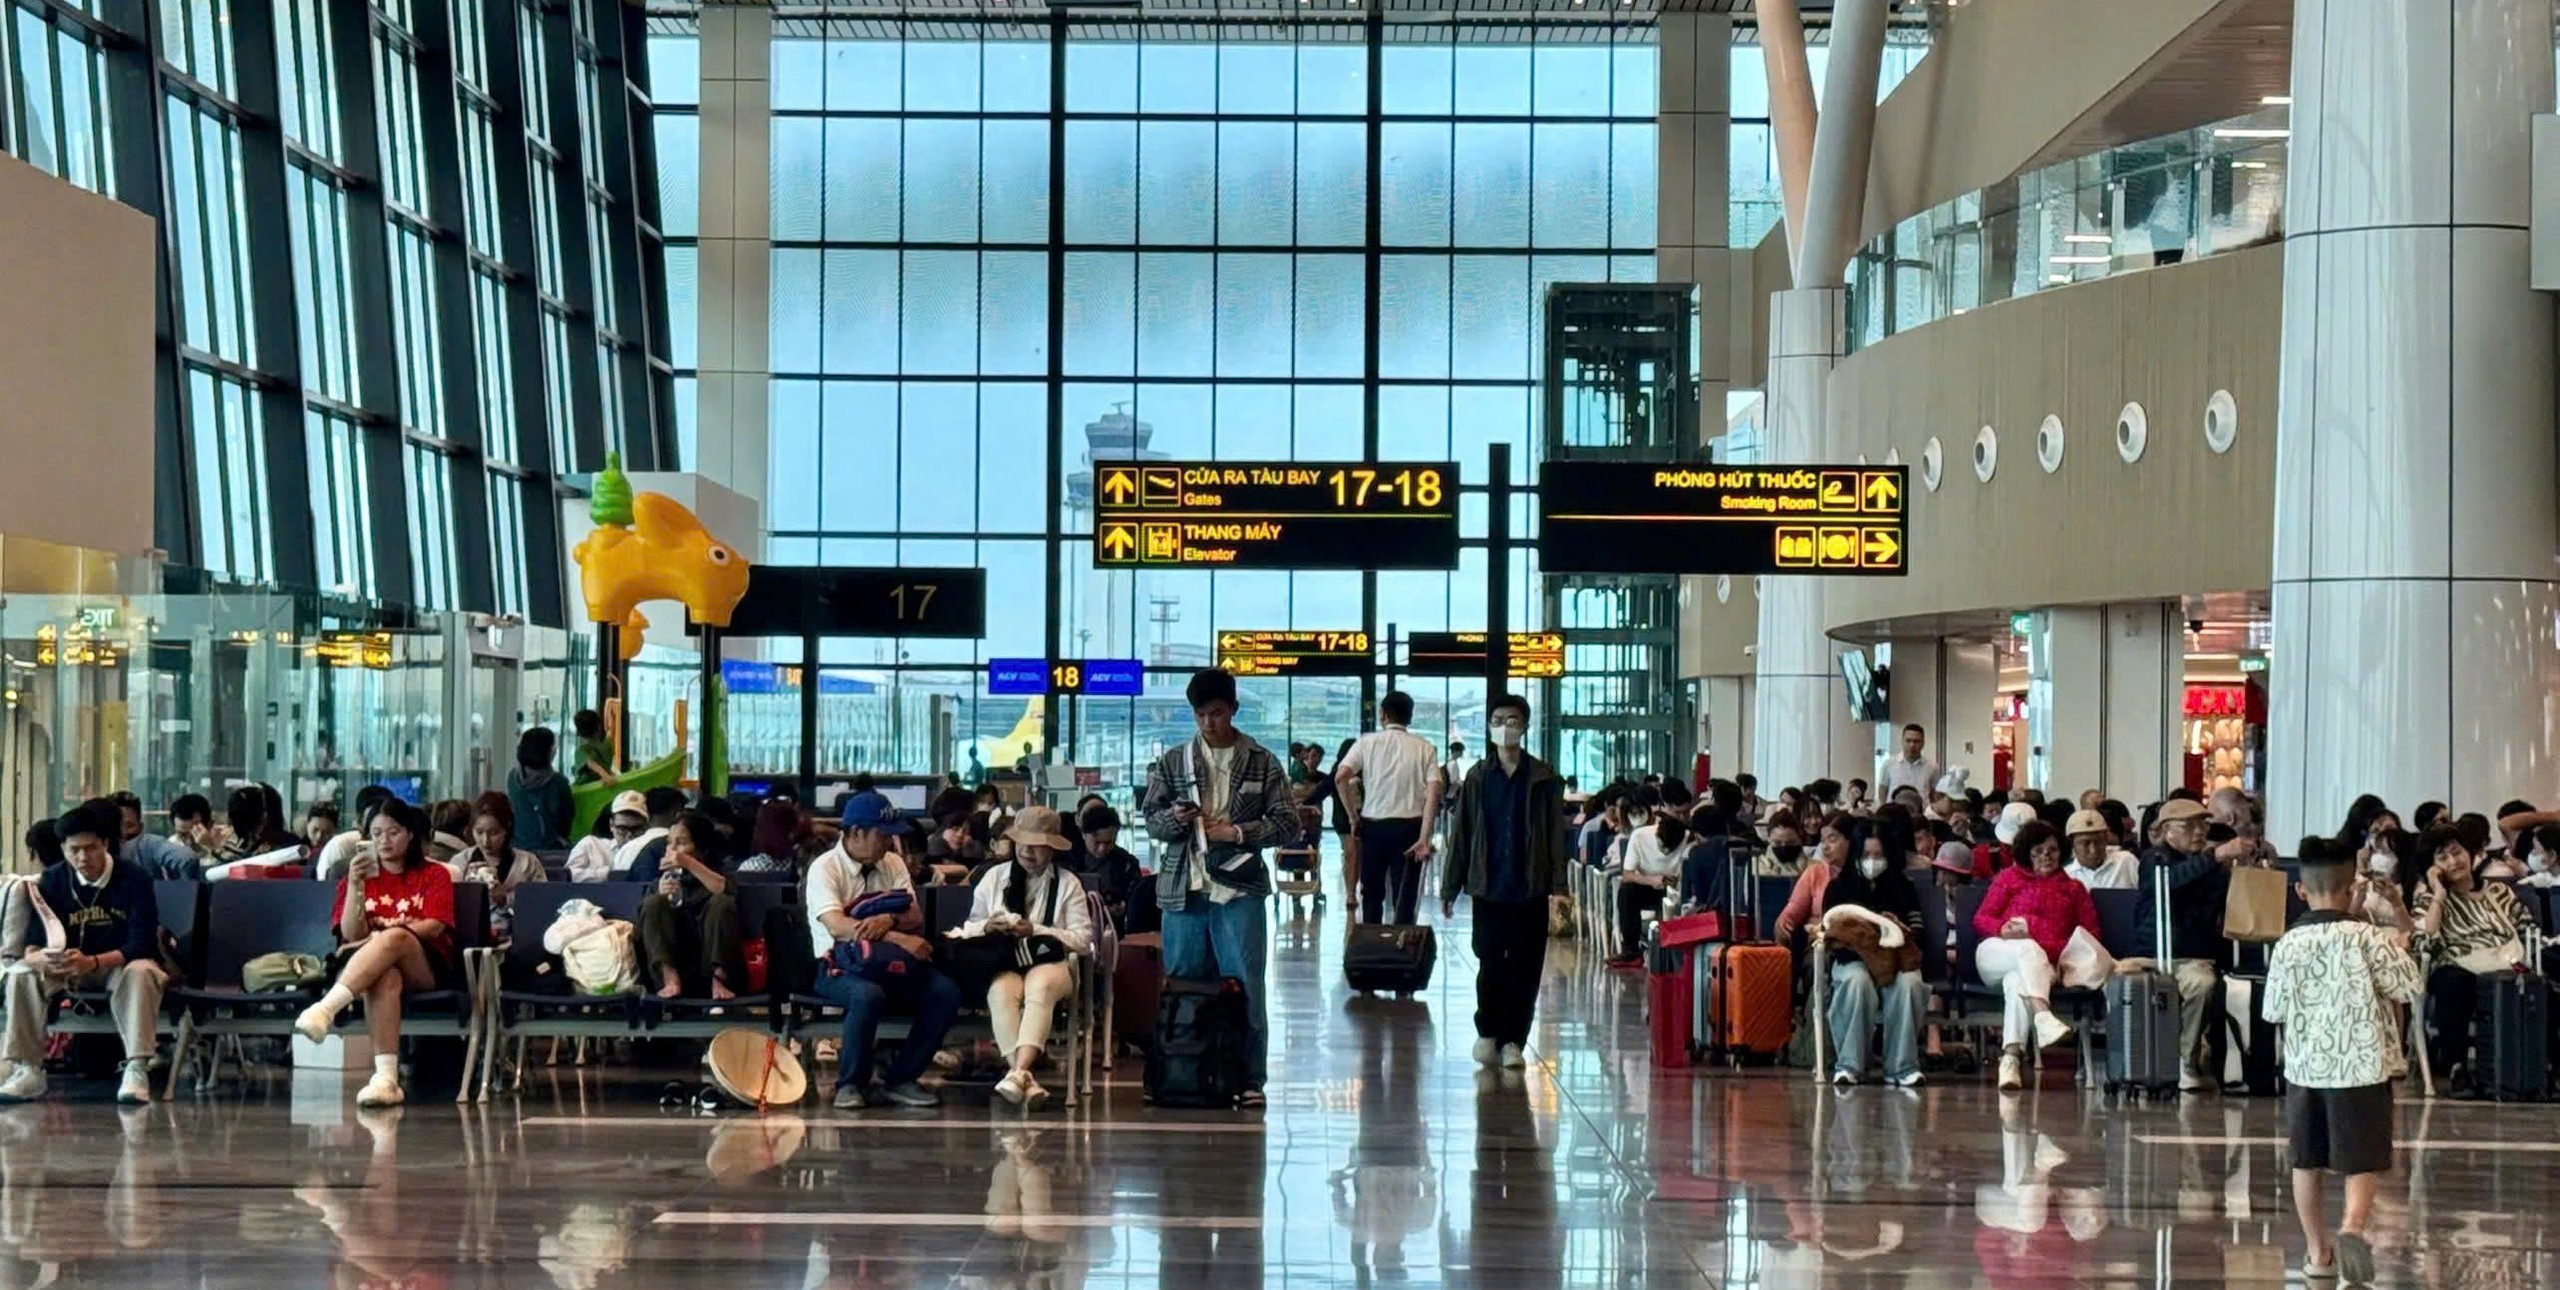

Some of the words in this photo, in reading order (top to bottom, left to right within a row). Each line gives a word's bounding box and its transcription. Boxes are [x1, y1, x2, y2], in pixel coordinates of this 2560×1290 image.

[1184, 466, 1220, 485] CỬA
[1223, 469, 1249, 485] RA
[1251, 467, 1285, 485] TÀU
[1287, 469, 1321, 485] BAY
[1654, 469, 1716, 488] PHÒNG
[1719, 470, 1754, 488] HÚT
[1757, 469, 1817, 489] THUỐC
[1329, 469, 1443, 507] 17-18
[1183, 492, 1223, 506] Gates
[1720, 495, 1776, 512] Smoking
[1778, 495, 1817, 510] Room
[1183, 524, 1243, 540] THANG
[1183, 546, 1237, 561] Elevator
[889, 583, 937, 620] 17
[1318, 633, 1368, 651] 17-18
[1053, 666, 1079, 688] 18
